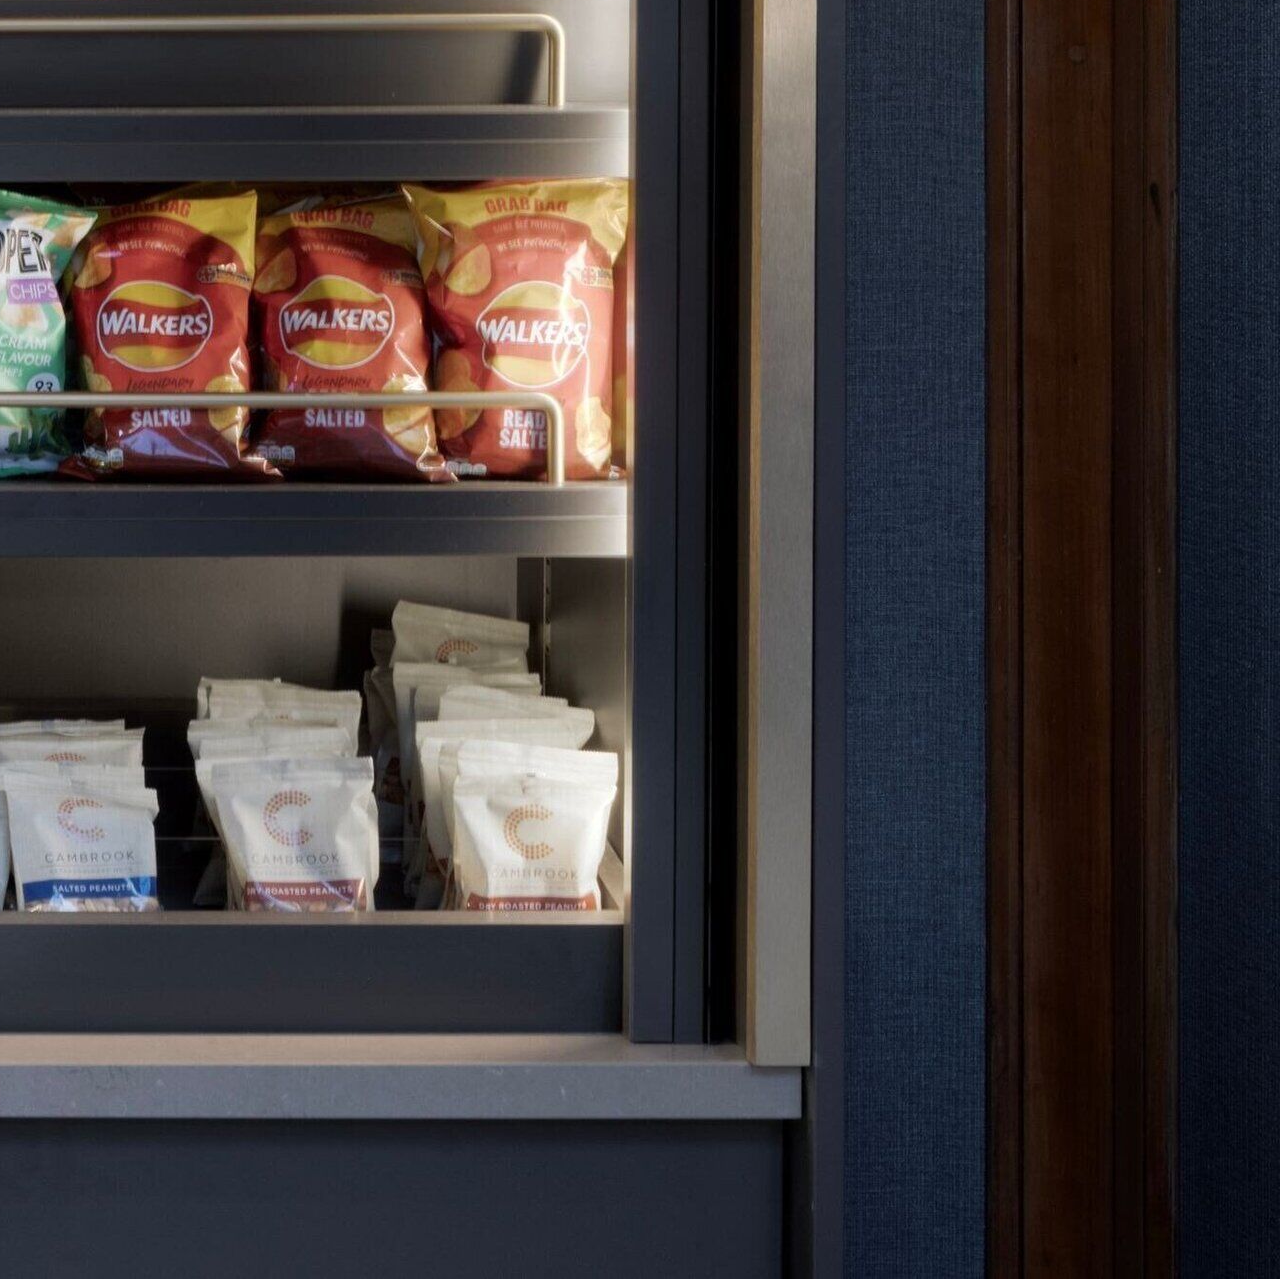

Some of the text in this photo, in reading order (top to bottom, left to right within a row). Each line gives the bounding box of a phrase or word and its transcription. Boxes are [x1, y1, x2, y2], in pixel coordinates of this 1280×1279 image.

[485, 196, 569, 214] GRAB BAG
[340, 211, 376, 230] BAG
[8, 281, 57, 304] CHIPS
[101, 307, 210, 336] WALKERS
[283, 309, 391, 333] WALKERS
[481, 319, 586, 347] WALKERS
[1, 350, 53, 367] FLAVOUR
[302, 376, 371, 391] LEGENDARY
[130, 409, 191, 428] SALTED
[304, 408, 366, 428] SALTED
[44, 851, 137, 864] CAMBROOK
[252, 853, 340, 866] CAMBROOK
[492, 868, 578, 881] CAMBROOK
[52, 882, 134, 894] SALTED PEANUTS
[265, 886, 307, 896] ROASTED
[498, 901, 543, 911] ROASTED
